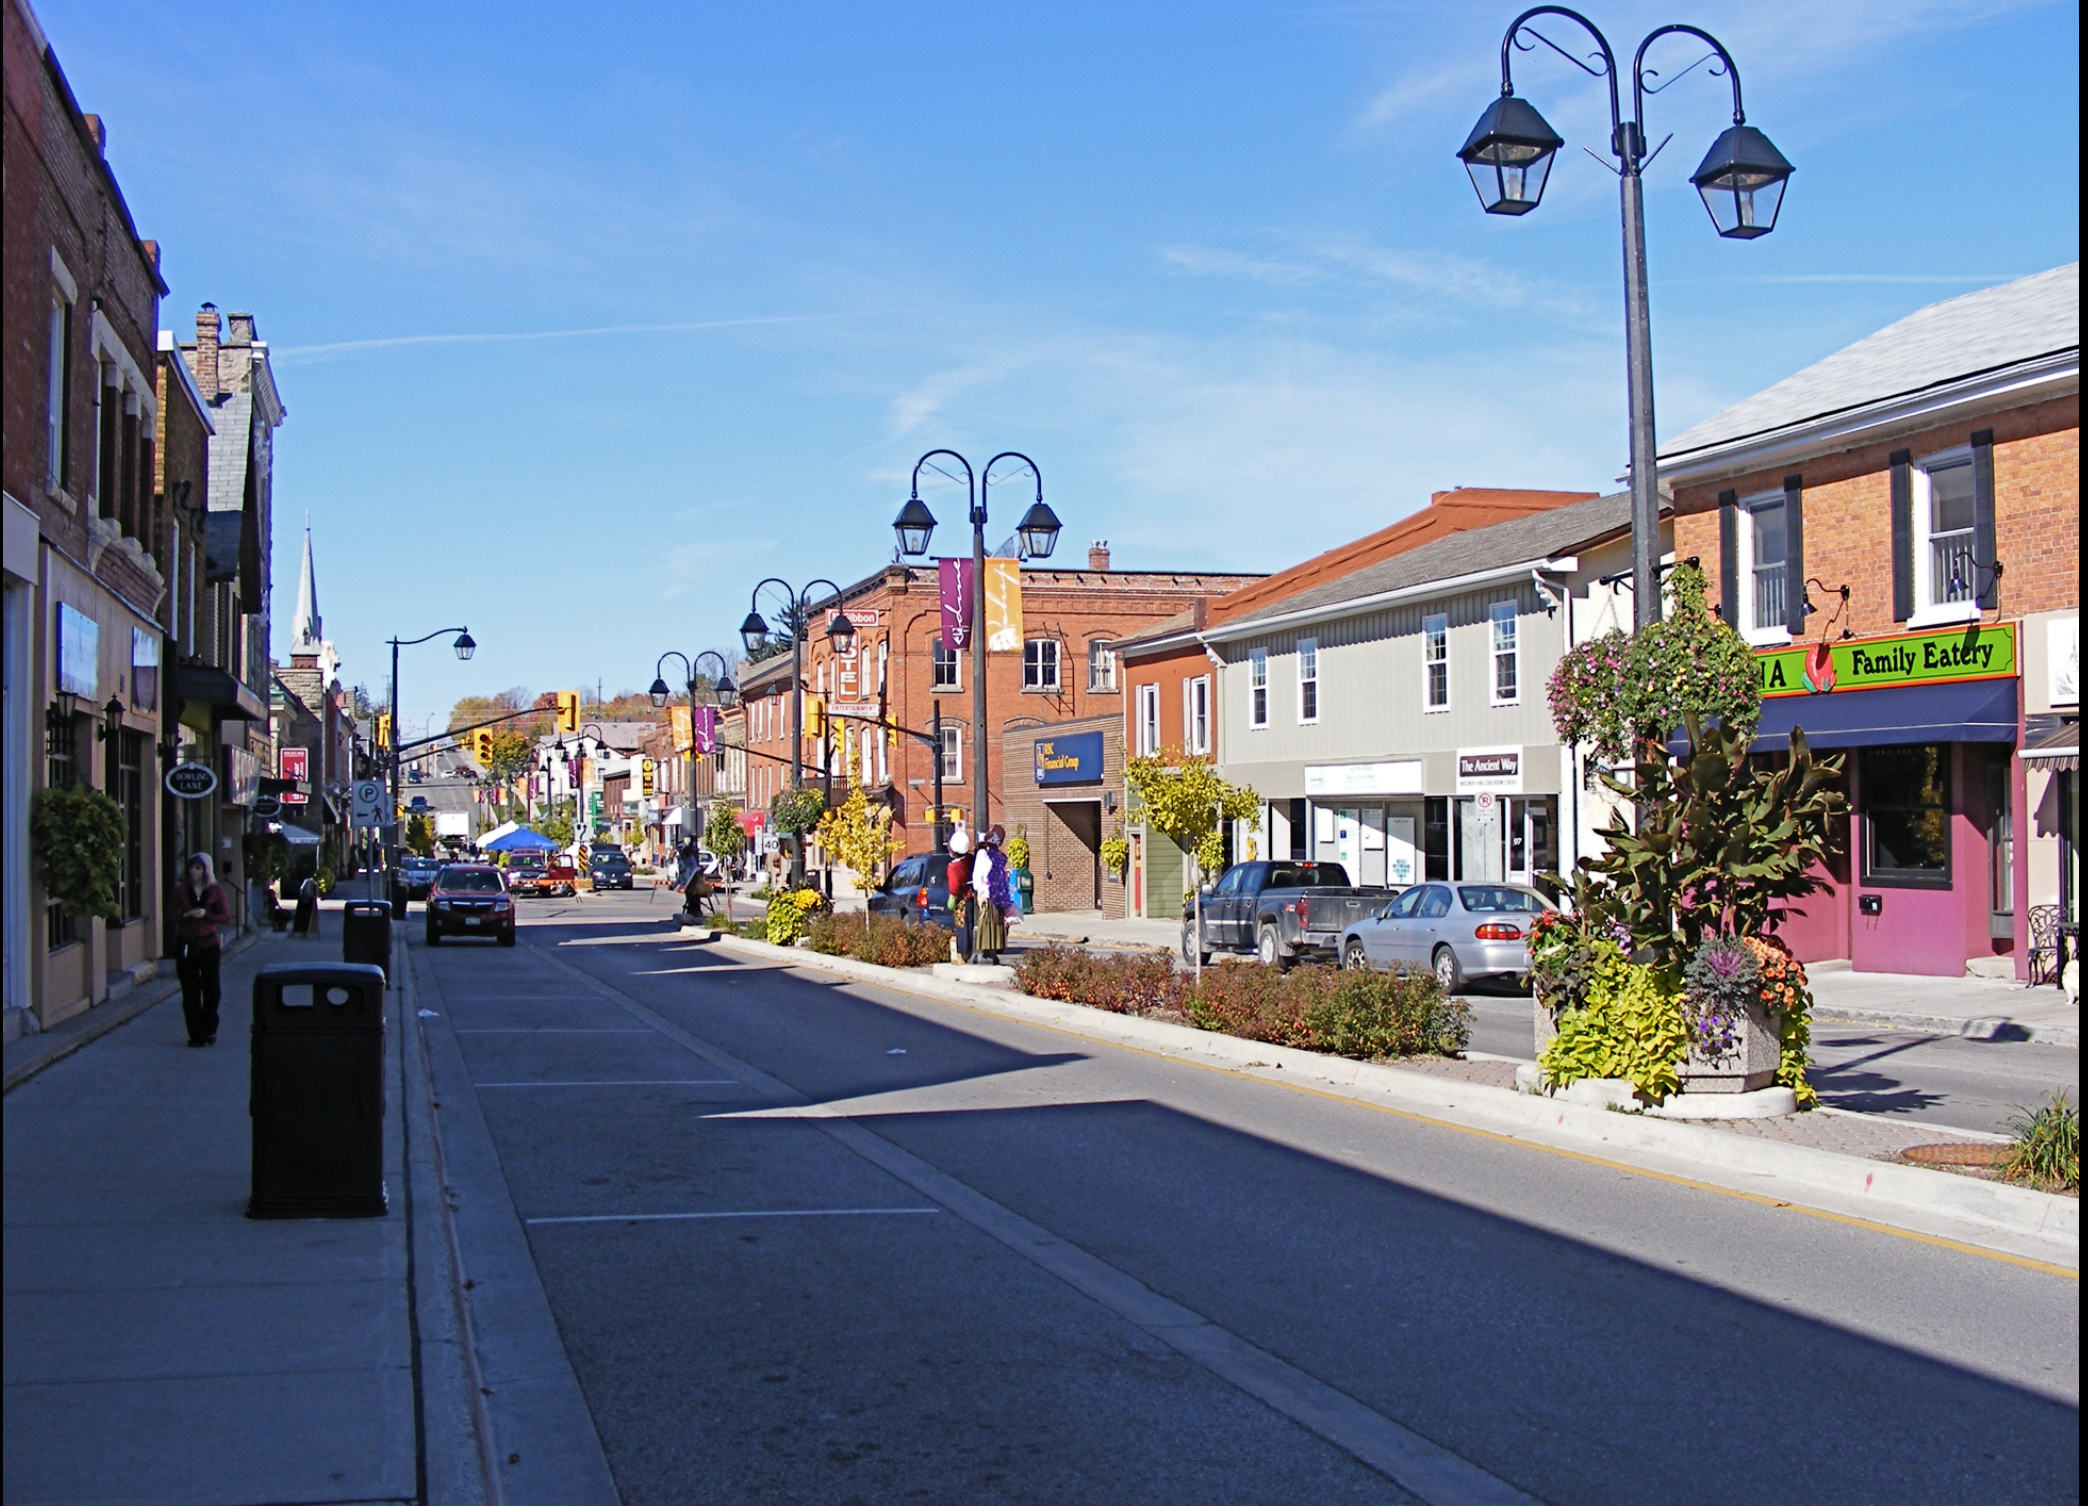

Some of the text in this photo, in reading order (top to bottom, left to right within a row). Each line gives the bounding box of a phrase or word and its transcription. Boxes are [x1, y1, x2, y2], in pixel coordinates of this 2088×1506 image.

[1852, 648, 1916, 676] Family
[1923, 640, 1994, 669] Eatery
[1064, 755, 1079, 771] Group
[1461, 757, 1517, 774] The Ancient Way
[180, 782, 203, 790] LANE
[764, 841, 779, 850] 40
[1513, 838, 1522, 846] 97
